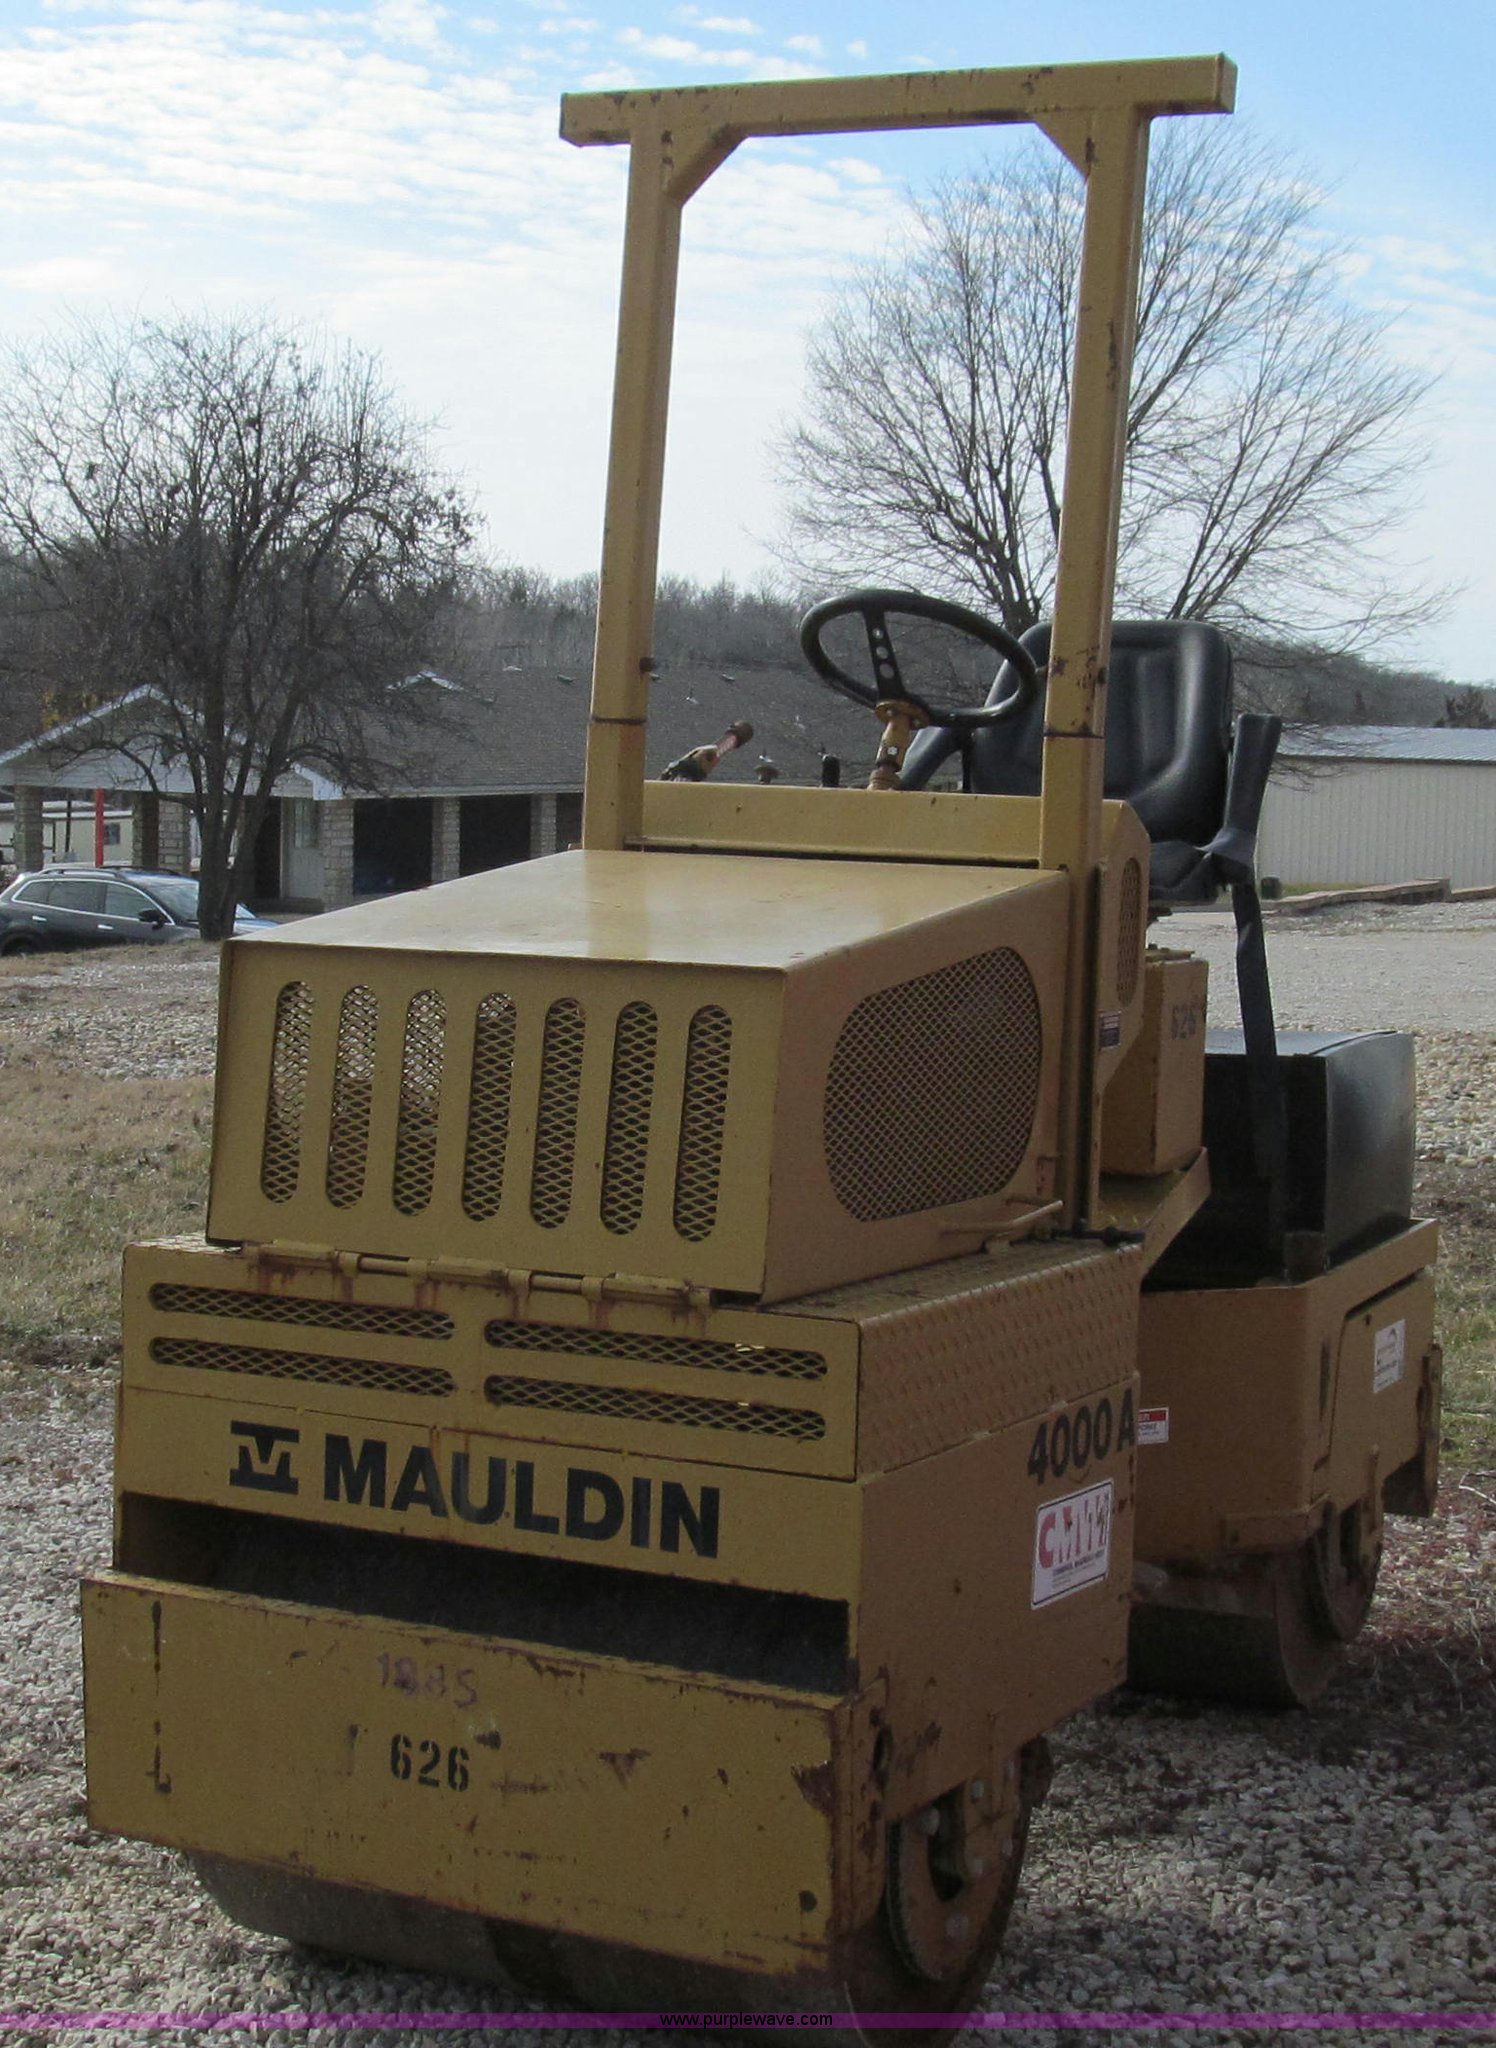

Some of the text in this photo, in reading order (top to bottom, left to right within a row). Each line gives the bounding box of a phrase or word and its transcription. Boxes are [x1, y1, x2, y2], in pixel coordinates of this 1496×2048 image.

[1028, 1387, 1136, 1485] 4000A
[323, 1433, 720, 1558] MAULDIN
[389, 1732, 471, 1793] 626
